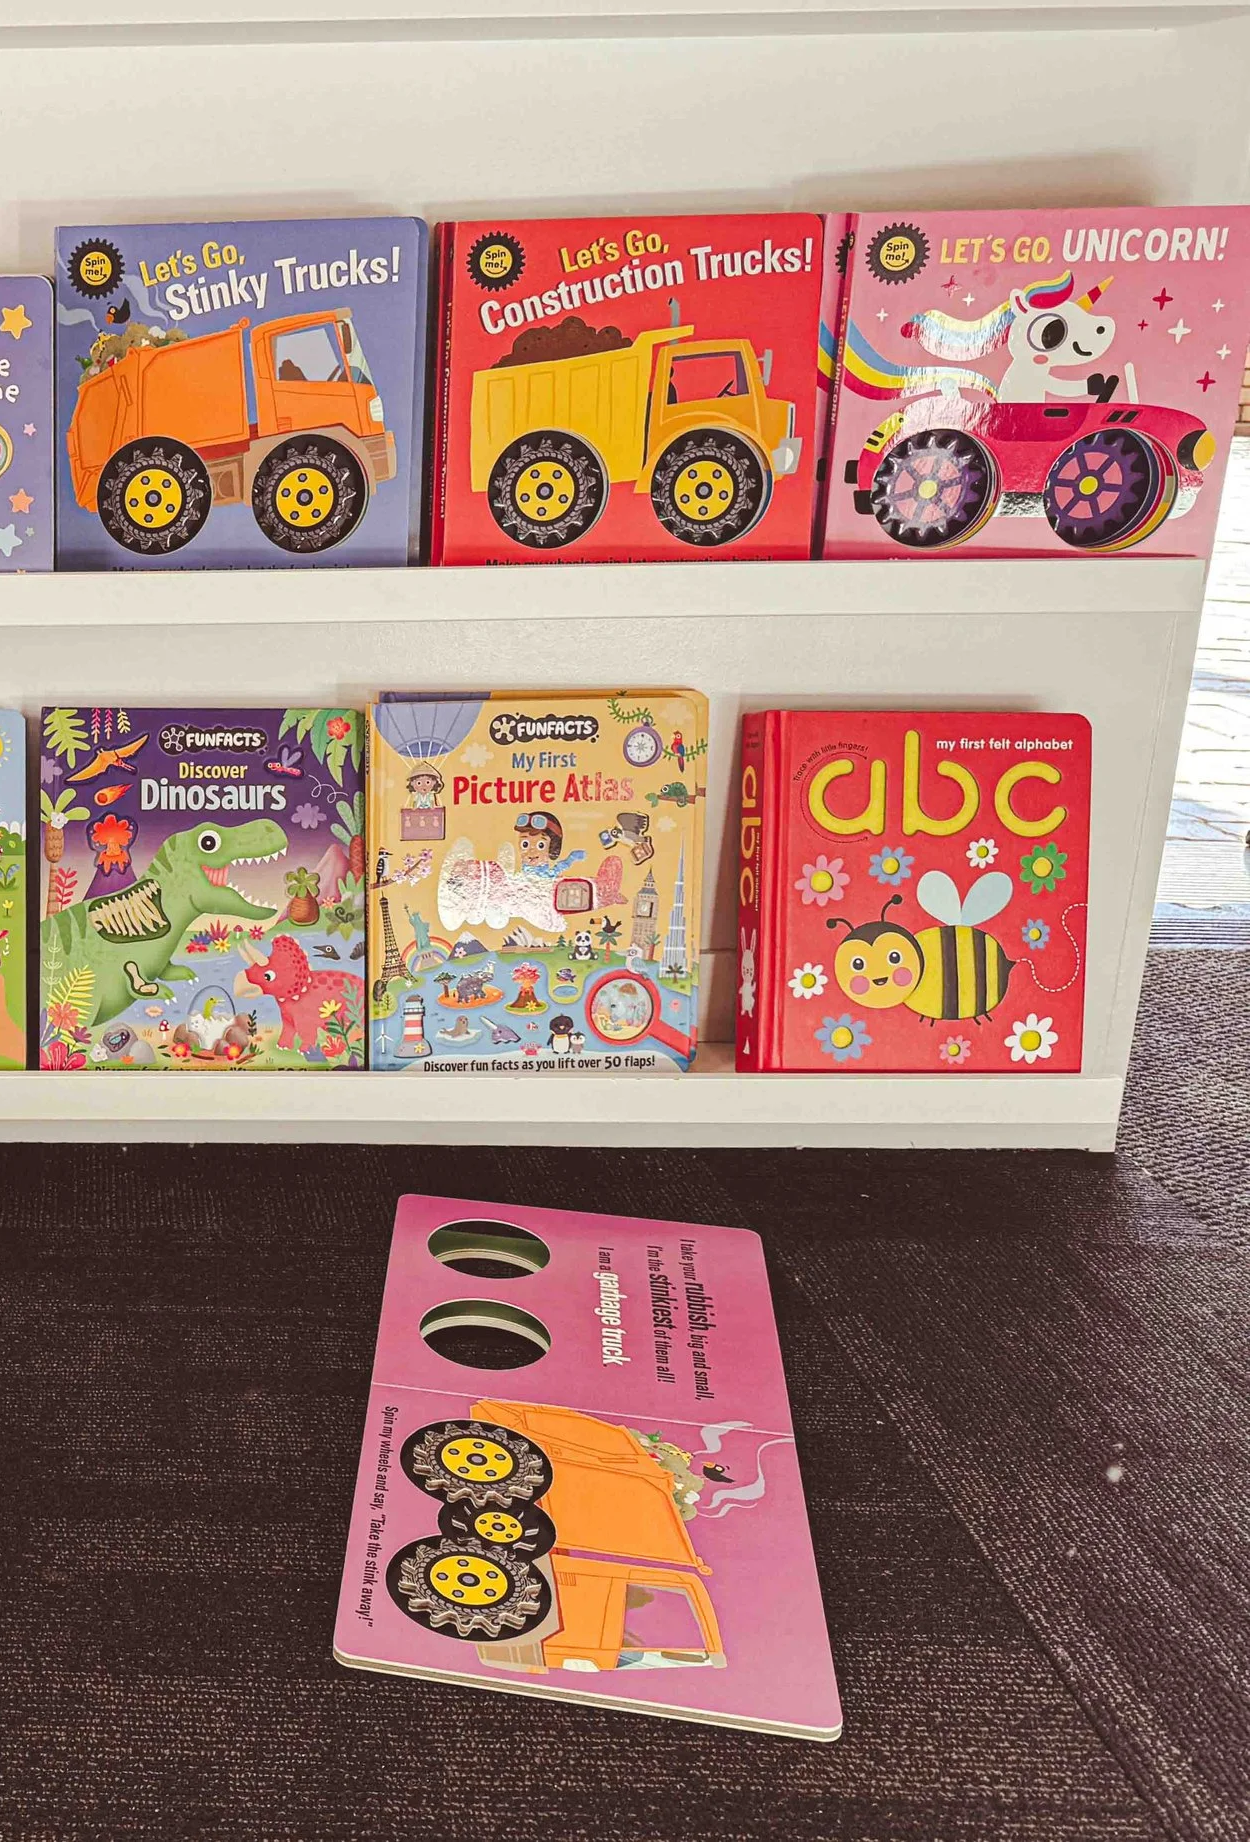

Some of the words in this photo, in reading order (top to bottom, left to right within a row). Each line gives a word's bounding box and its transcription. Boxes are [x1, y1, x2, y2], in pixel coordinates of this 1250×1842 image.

[485, 250, 507, 261] Spin
[559, 237, 619, 273] Let's
[623, 230, 670, 257] Go,
[886, 242, 910, 254] Spin
[939, 234, 1006, 264] LET'S
[1012, 236, 1054, 265] GO,
[1061, 227, 1230, 263] UNICORN!
[85, 256, 107, 268] Spin
[85, 267, 104, 276] me!
[138, 249, 198, 288] Let's
[201, 241, 246, 270] Go,
[163, 271, 269, 321] Stinky
[274, 246, 401, 295] Trucks!
[479, 258, 684, 336] Construction
[689, 237, 814, 282] Trucks!
[517, 720, 596, 738] FUNFACTS
[186, 732, 263, 748] FUNFACTS
[936, 739, 955, 752] my
[960, 738, 985, 750] first
[989, 738, 1011, 750] felt
[1014, 738, 1073, 752] alphabet
[179, 762, 248, 780] Discover
[511, 752, 535, 773] My
[539, 752, 577, 768] First
[453, 775, 556, 805] Picture
[562, 772, 635, 803] Atlas
[808, 730, 1068, 837] abc
[140, 778, 288, 811] Dinosaurs
[740, 765, 762, 907] abc
[424, 1061, 469, 1072] Discover
[470, 1060, 489, 1071] fun
[491, 1060, 519, 1071] facts
[521, 1062, 534, 1070] as
[535, 1061, 556, 1072] you
[558, 1058, 575, 1069] lift
[578, 1059, 601, 1068] over
[604, 1056, 621, 1070] 50
[625, 1055, 655, 1068] flaps!
[599, 1250, 611, 1265] am
[647, 1245, 663, 1258] I'm
[681, 1242, 698, 1262] take
[648, 1257, 666, 1272] the
[679, 1261, 696, 1281] your
[593, 1271, 628, 1326] garbage
[649, 1273, 679, 1330] stinkiest
[684, 1282, 717, 1332] rubbish,
[654, 1329, 672, 1340] of
[687, 1334, 709, 1349] big
[602, 1328, 632, 1368] truck.
[655, 1340, 672, 1365] them
[692, 1350, 712, 1370] and
[657, 1365, 676, 1384] all!
[694, 1369, 715, 1401] small,
[382, 1405, 398, 1426] Spin
[378, 1426, 393, 1439] my
[376, 1438, 394, 1473] wheels
[375, 1473, 389, 1490] and
[370, 1491, 385, 1511] say,
[367, 1541, 382, 1559] the
[362, 1559, 378, 1588] stink
